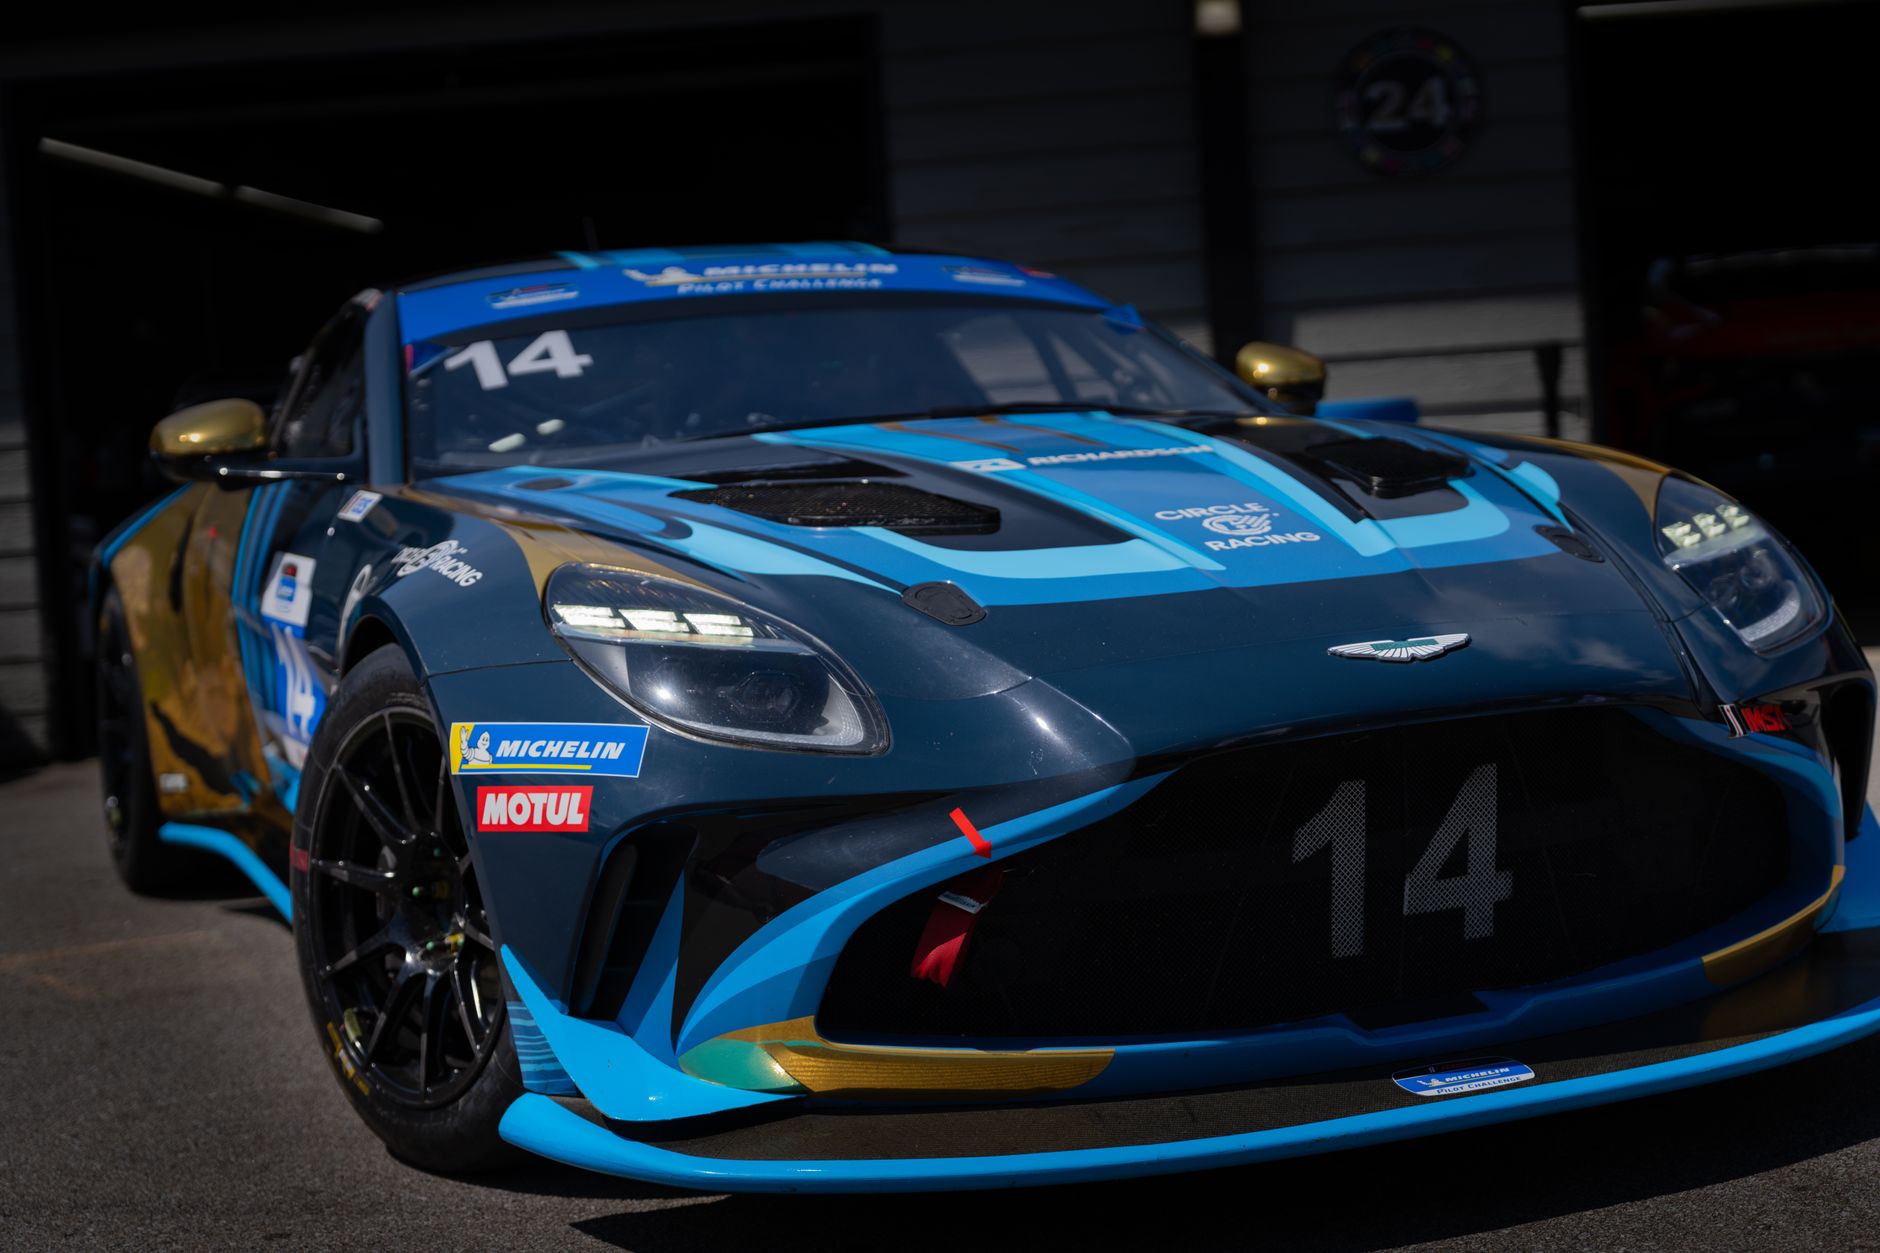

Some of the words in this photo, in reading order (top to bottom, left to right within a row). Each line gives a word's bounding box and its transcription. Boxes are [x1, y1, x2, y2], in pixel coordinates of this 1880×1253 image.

[1362, 75, 1450, 133] 24
[704, 263, 898, 276] MICHELIN
[443, 329, 594, 391] 14
[1027, 444, 1213, 465] RICHARDSON
[1154, 502, 1270, 520] CIRCLE
[1204, 532, 1320, 551] RACING
[270, 621, 316, 738] 14
[495, 740, 626, 760] MICHELIN
[482, 792, 584, 825] MOTUL
[1291, 762, 1514, 959] 14
[1445, 1067, 1510, 1082] MICHELIN
[1436, 1086, 1465, 1095] PILOT
[1468, 1076, 1521, 1089] CHALLENGE
